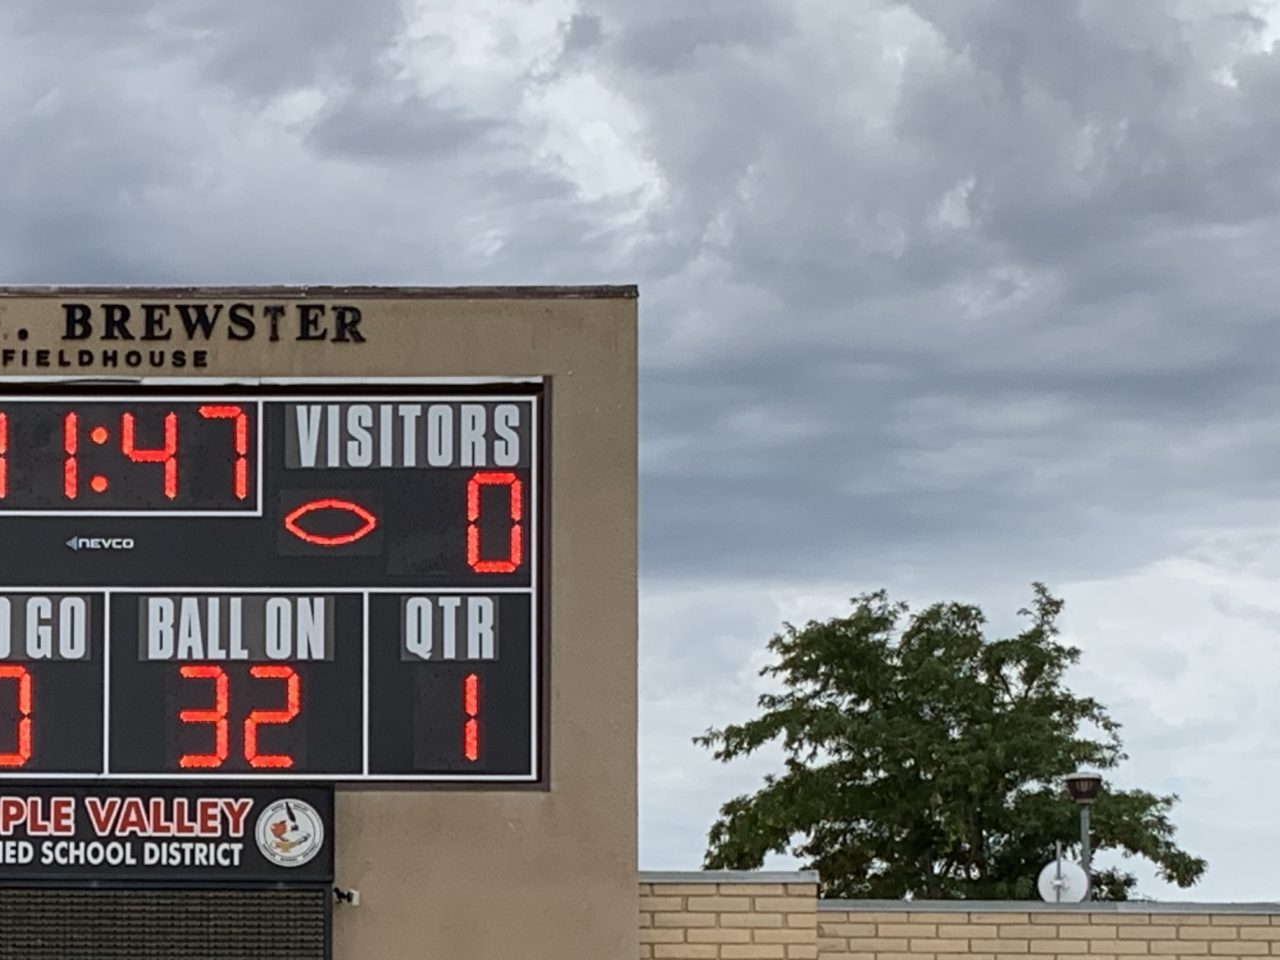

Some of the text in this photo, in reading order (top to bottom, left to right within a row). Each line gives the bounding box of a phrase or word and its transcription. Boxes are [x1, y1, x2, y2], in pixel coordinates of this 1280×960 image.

[61, 304, 366, 343] BREWSTER
[2, 349, 208, 368] FIELDHOUSE
[296, 404, 520, 467] VISITORS
[467, 472, 521, 573] 0
[26, 596, 86, 659] GO
[147, 597, 325, 660] BALL ON
[405, 597, 494, 660] QTR
[179, 665, 300, 768] 32
[463, 673, 480, 762] 1
[85, 797, 253, 838] VALLEY
[41, 841, 136, 865] SCHOOL
[144, 842, 243, 866] DISTRICT
